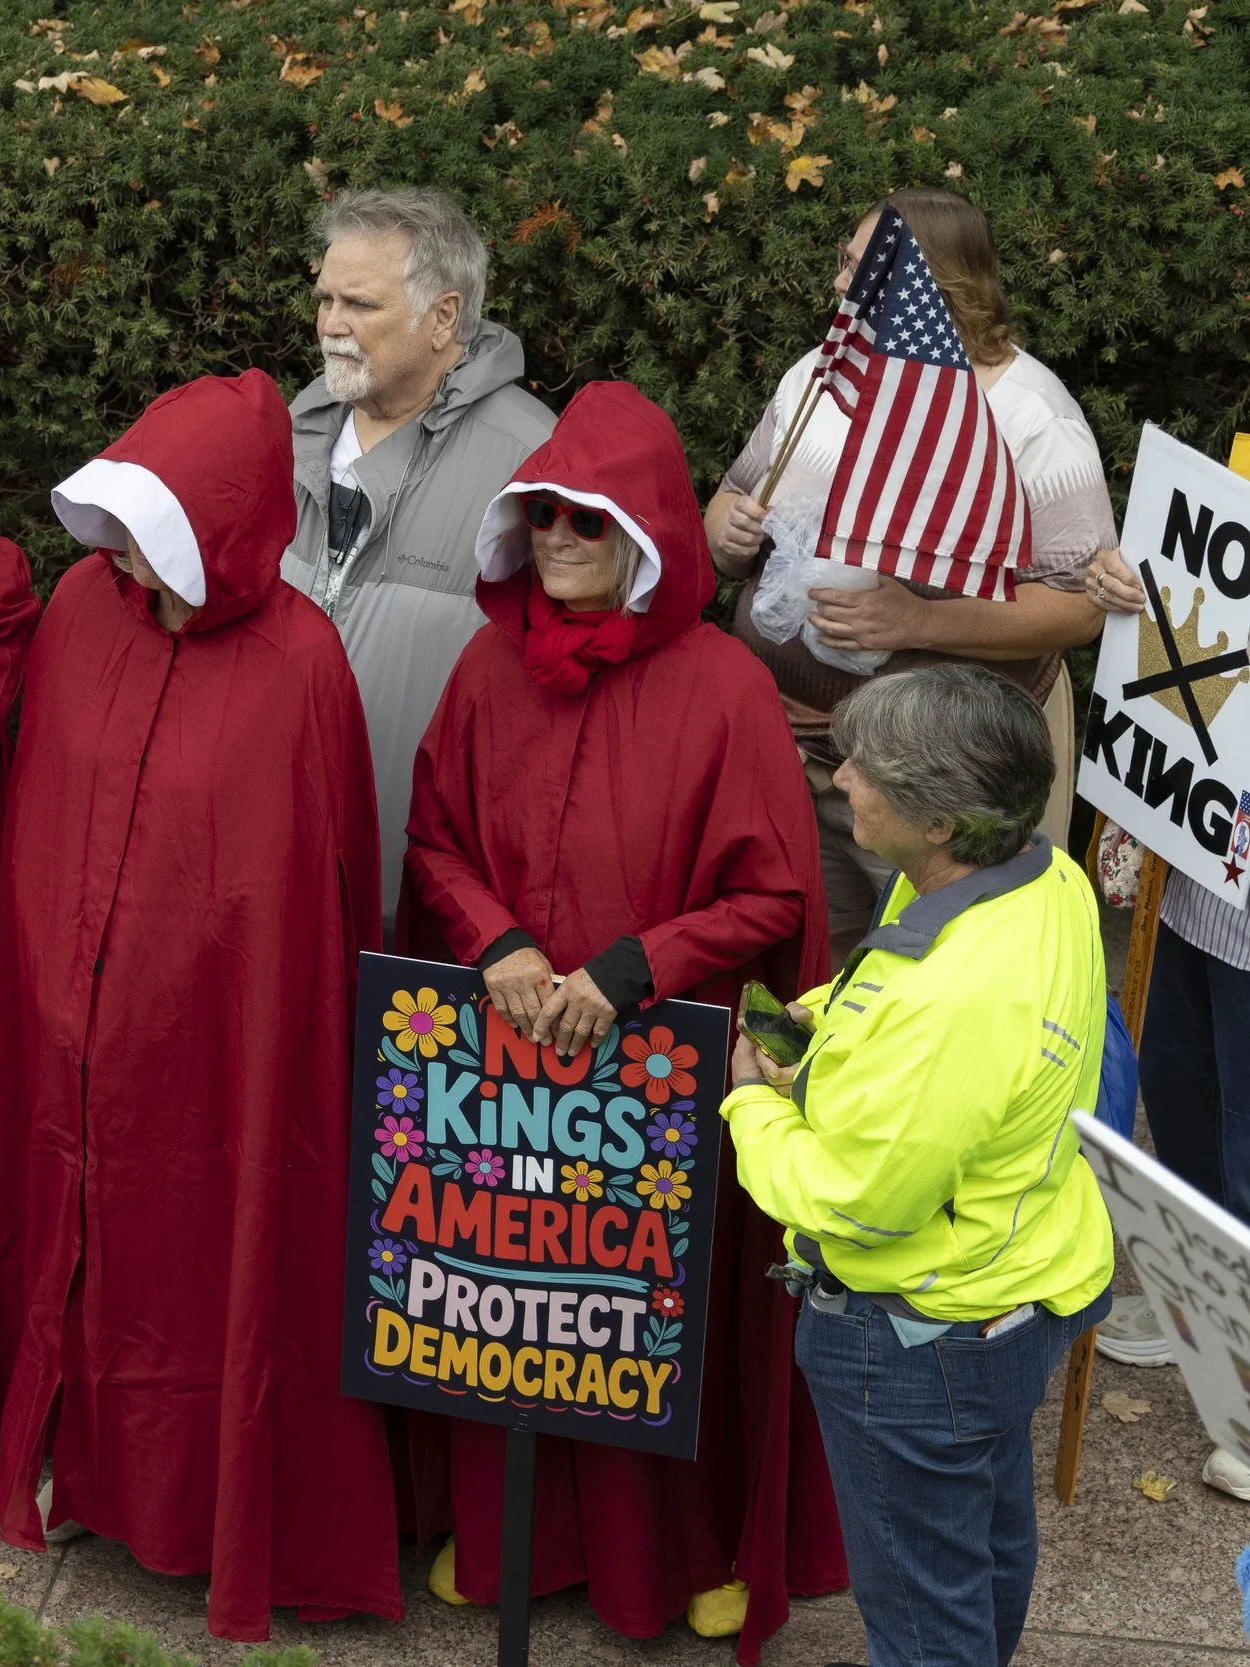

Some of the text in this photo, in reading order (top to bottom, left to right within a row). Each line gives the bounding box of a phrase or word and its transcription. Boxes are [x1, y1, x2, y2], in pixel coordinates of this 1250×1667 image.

[406, 555, 450, 573] Columbia
[1161, 487, 1250, 600] NO
[380, 1162, 675, 1278] AMERICA
[512, 1154, 554, 1194] IN
[407, 1257, 648, 1352] PROTECT
[372, 1308, 674, 1415] DEMOCRACY
